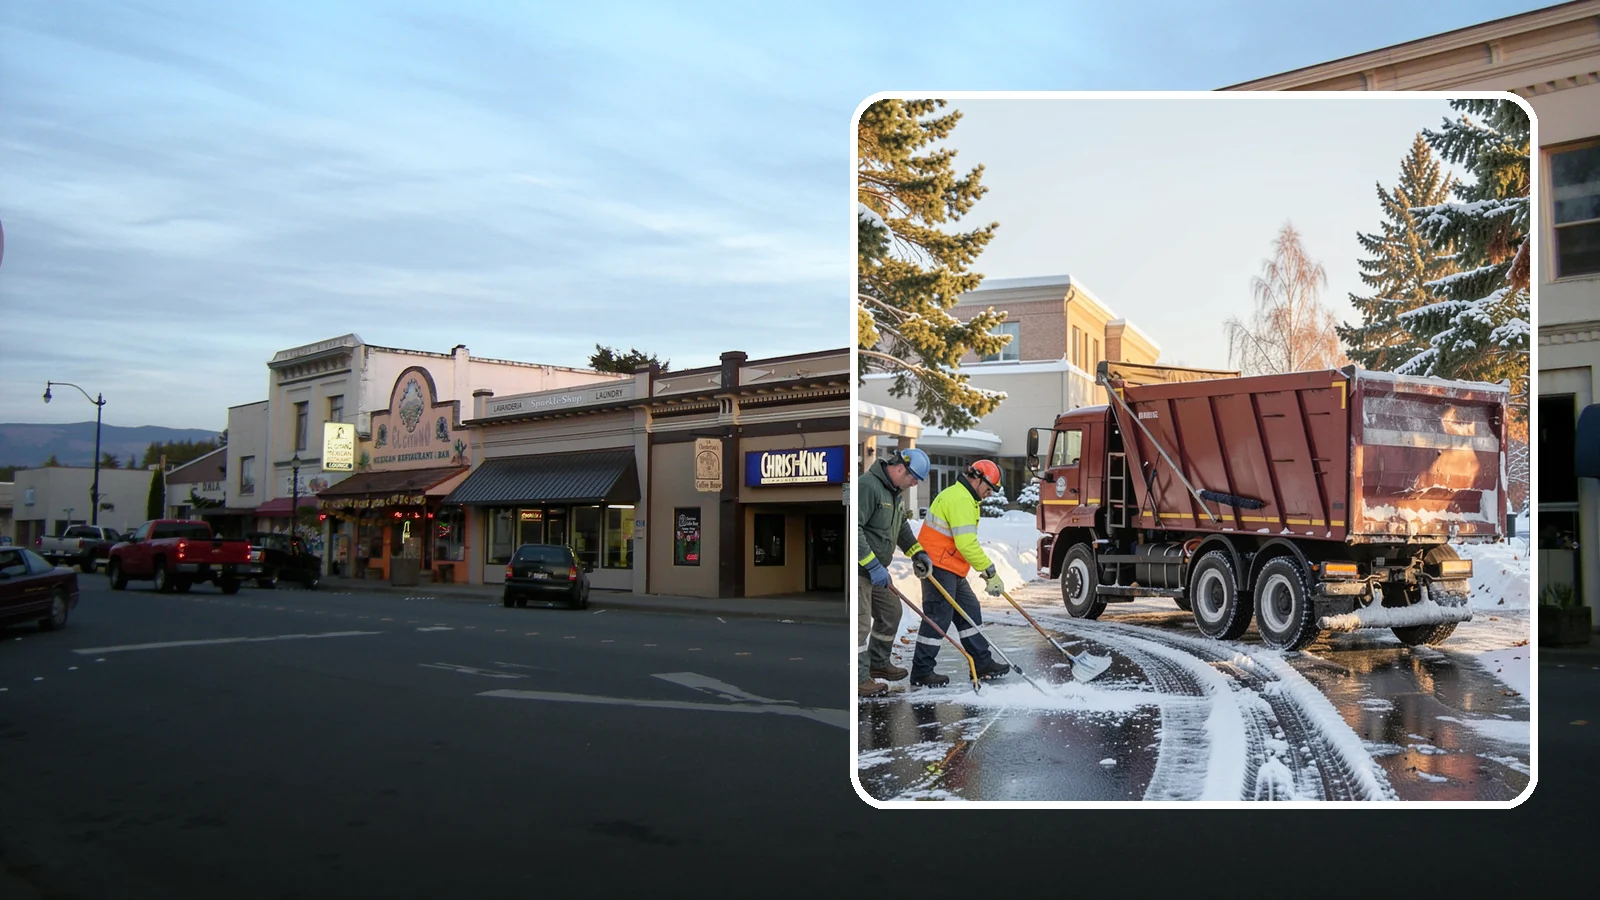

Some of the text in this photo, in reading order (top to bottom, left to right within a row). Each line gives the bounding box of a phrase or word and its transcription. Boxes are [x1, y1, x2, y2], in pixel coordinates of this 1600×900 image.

[493, 389, 623, 412] LAVANDERIA Sparkle Shop LAUNDRY
[373, 455, 396, 464] MEXICAN
[397, 451, 433, 463] RESTAURANT
[438, 450, 450, 459] BAR
[760, 449, 827, 478] CHRIST KING
[696, 480, 722, 489] Coffee House
